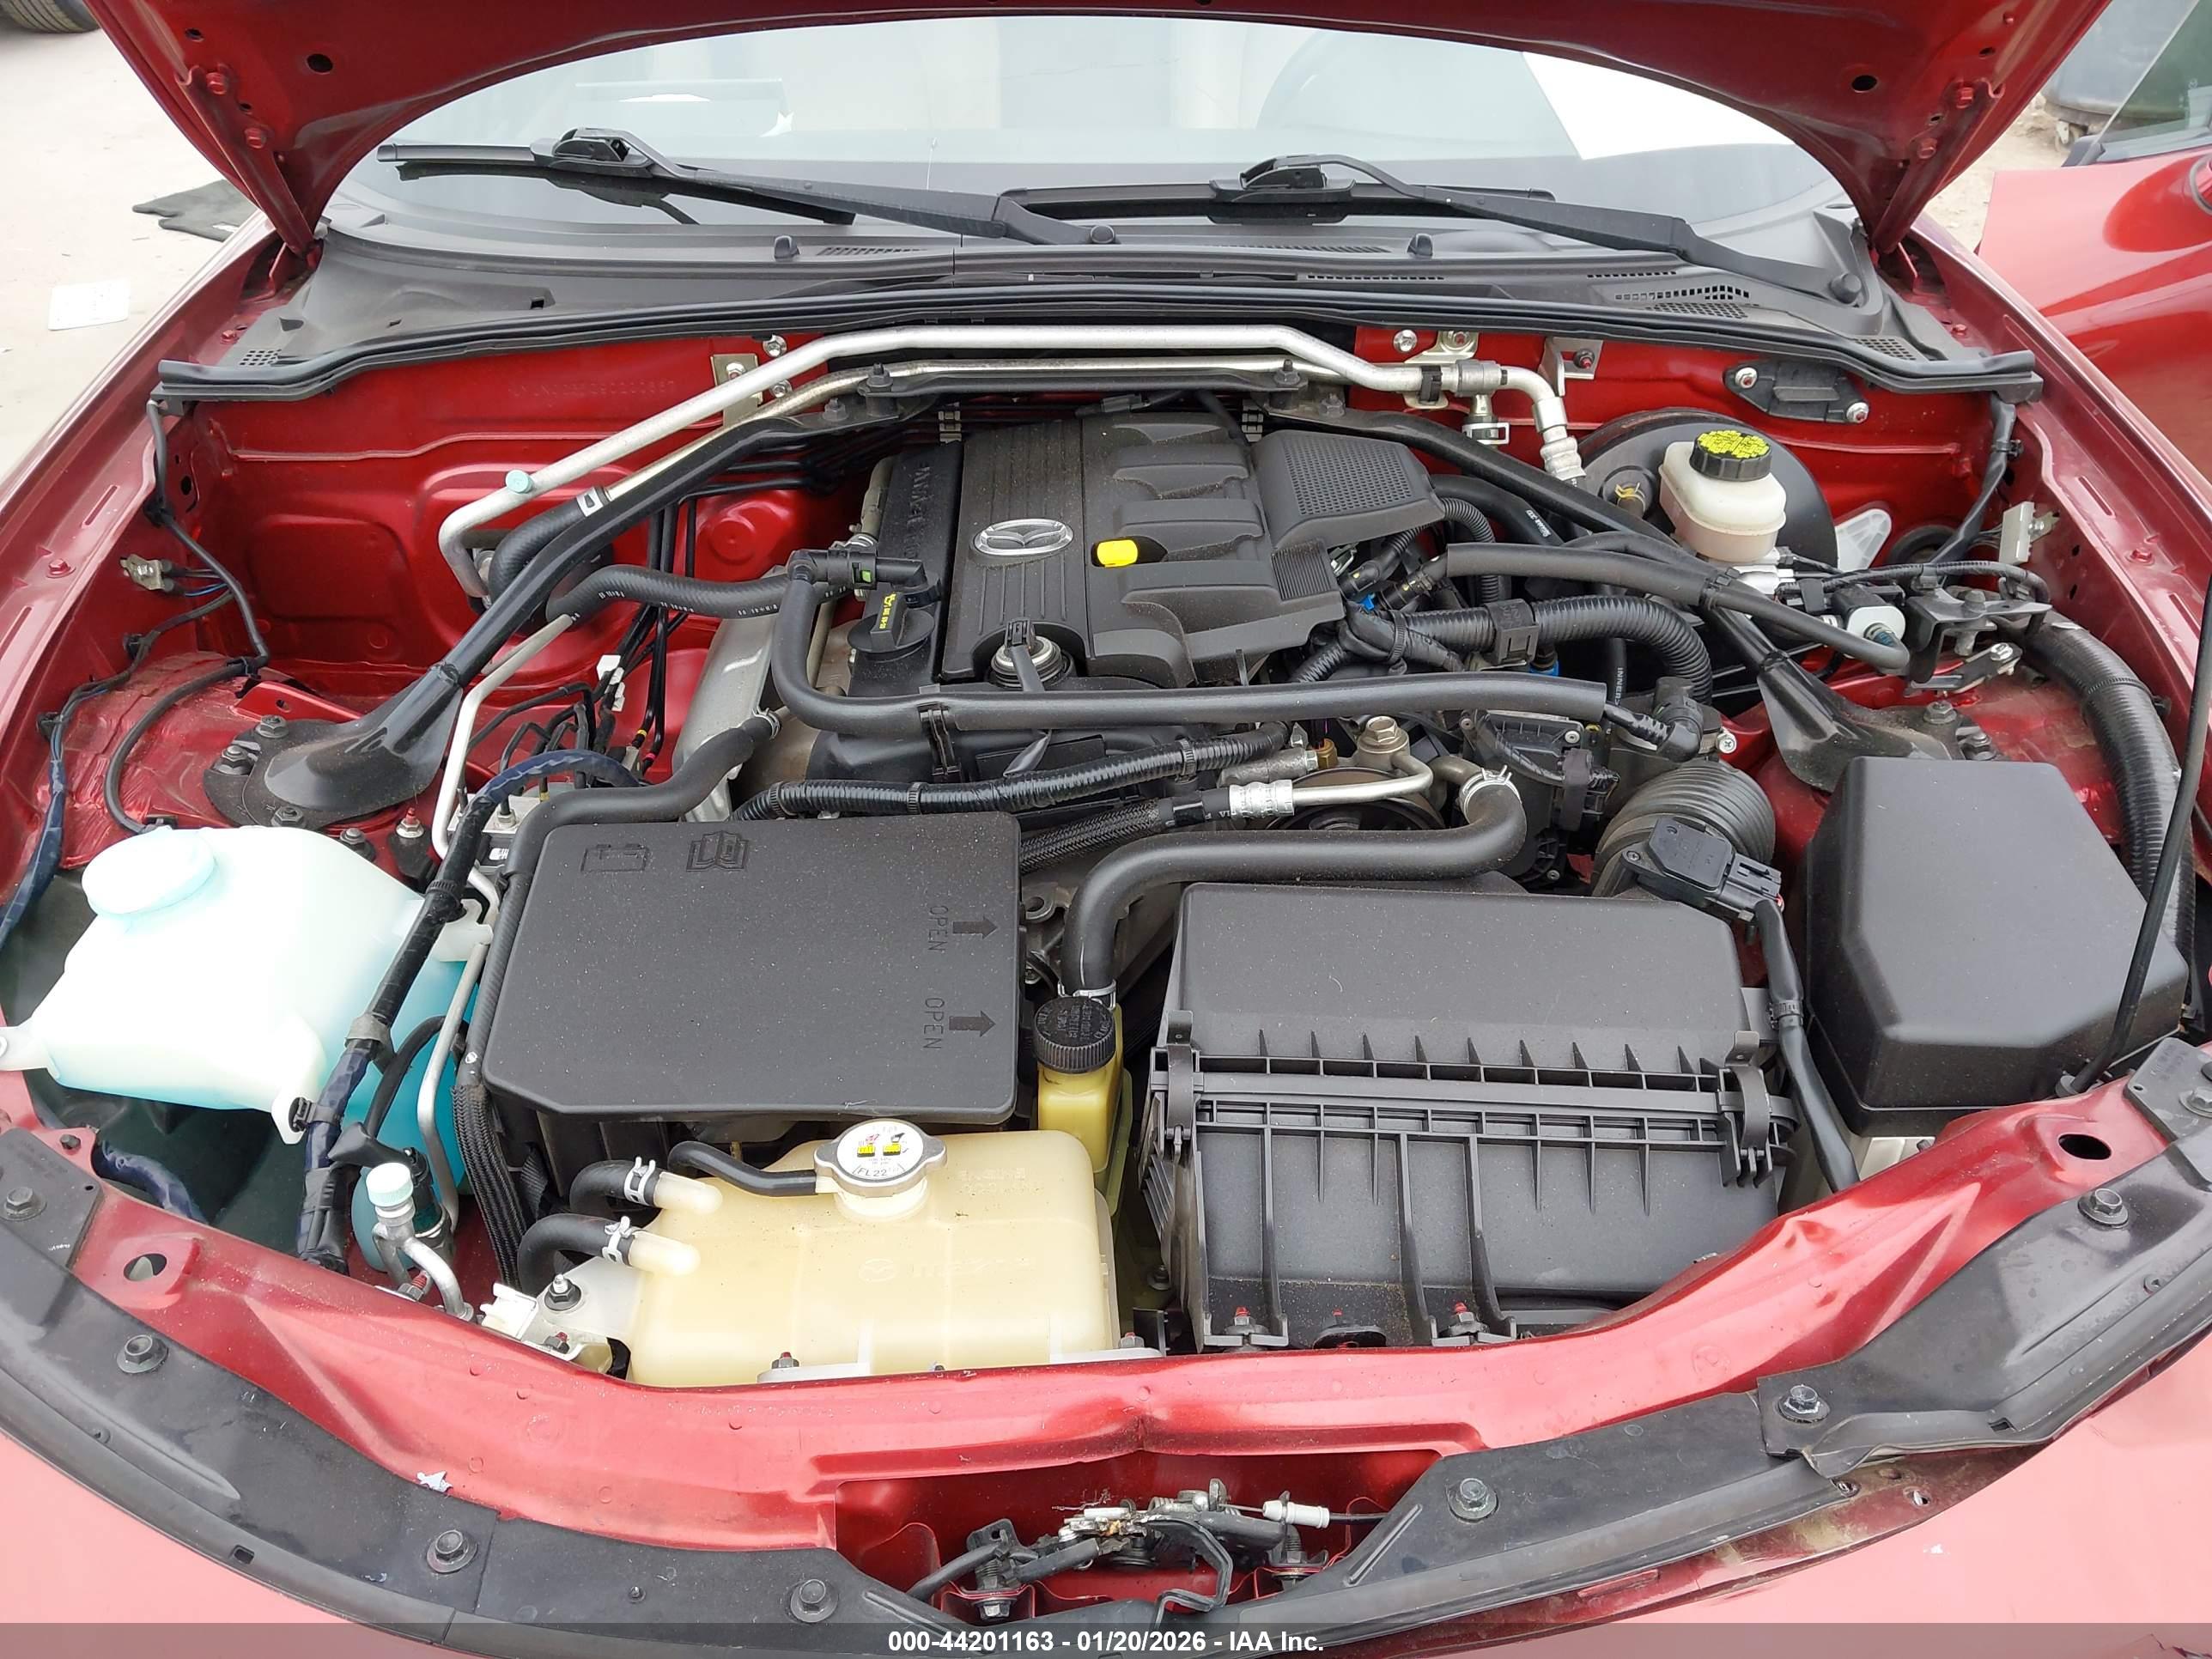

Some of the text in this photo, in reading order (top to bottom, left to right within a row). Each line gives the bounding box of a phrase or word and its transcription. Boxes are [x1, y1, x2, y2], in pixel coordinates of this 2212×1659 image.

[927, 904, 949, 951] OPEN
[923, 997, 945, 1049] OPEN
[857, 1167, 888, 1177] FL22
